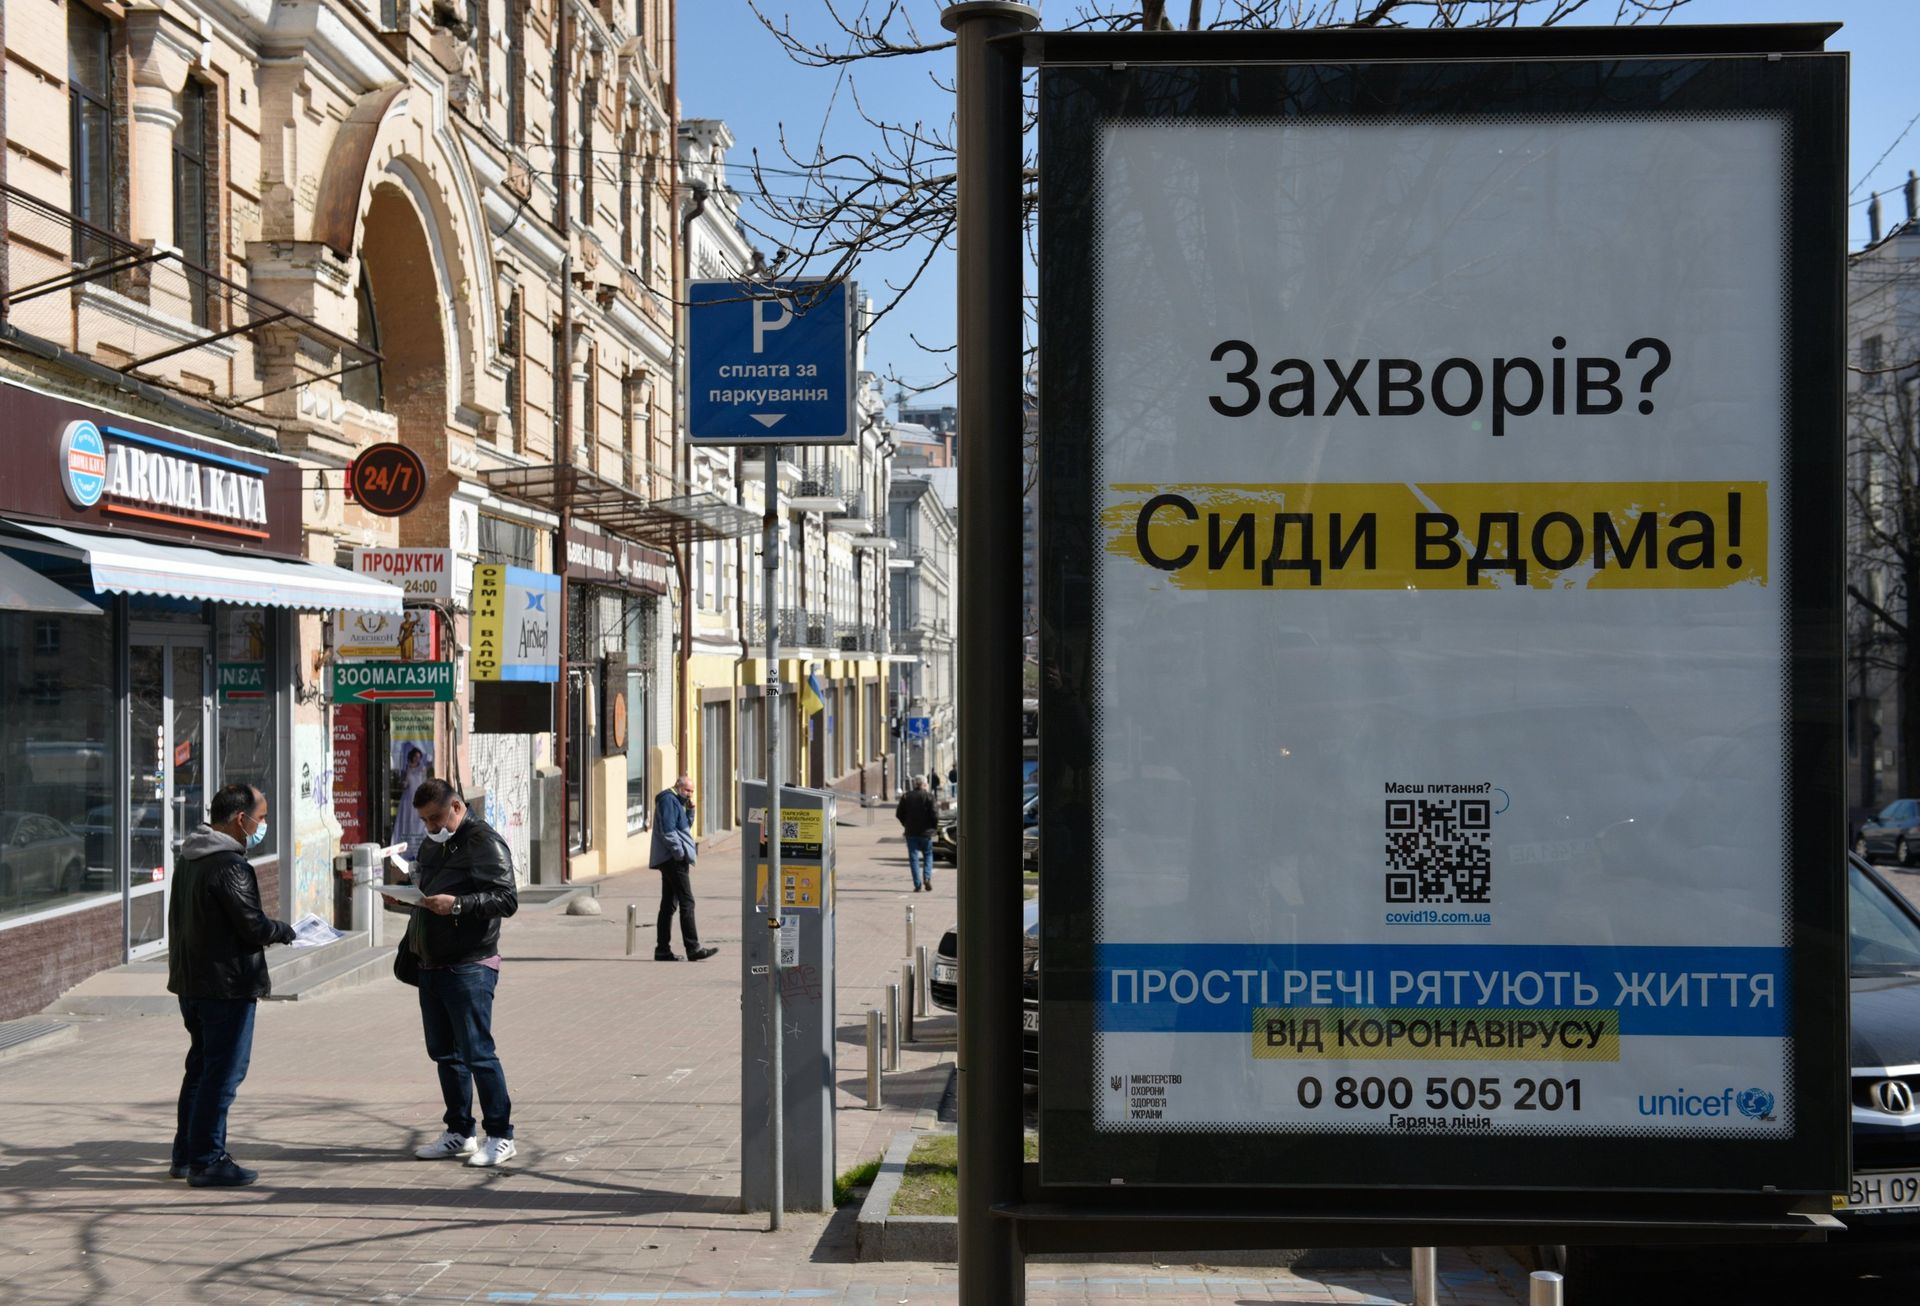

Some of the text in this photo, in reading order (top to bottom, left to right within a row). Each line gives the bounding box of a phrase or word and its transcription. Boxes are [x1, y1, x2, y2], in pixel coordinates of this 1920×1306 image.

[753, 293, 794, 353] P
[718, 364, 817, 378] сплата за
[709, 388, 828, 406] паркування
[1208, 336, 1672, 437] Захворів?
[109, 444, 267, 524] AROMA KAVA
[364, 465, 413, 497] 24/7
[1135, 492, 1744, 586] Сиди вдома!
[362, 552, 444, 576] ПРОДУКТИ
[404, 579, 437, 593] 24:00
[476, 568, 497, 678] ОБМІН ВАЛЮТ
[337, 666, 450, 686] ЗООМАГАЗИН
[1385, 782, 1491, 794] Маєш питання?
[1385, 910, 1491, 923] covid19.com.ua
[1111, 969, 1775, 1008] ПРОСТІ РЕЧІ РЯТУЮТЬ ЖИТТЯ
[1266, 1019, 1606, 1053] ВІД КОРОНАВІРУСУ
[1130, 1074, 1182, 1085] МІНІСТЕРСТВО
[1130, 1086, 1165, 1096] ОХОРОНИ
[1297, 1076, 1581, 1111] 0 800 505 201
[1639, 1087, 1734, 1116] unicef
[1130, 1109, 1163, 1119] УКРАЇНИ
[1389, 1113, 1491, 1130] Гаряча лінія
